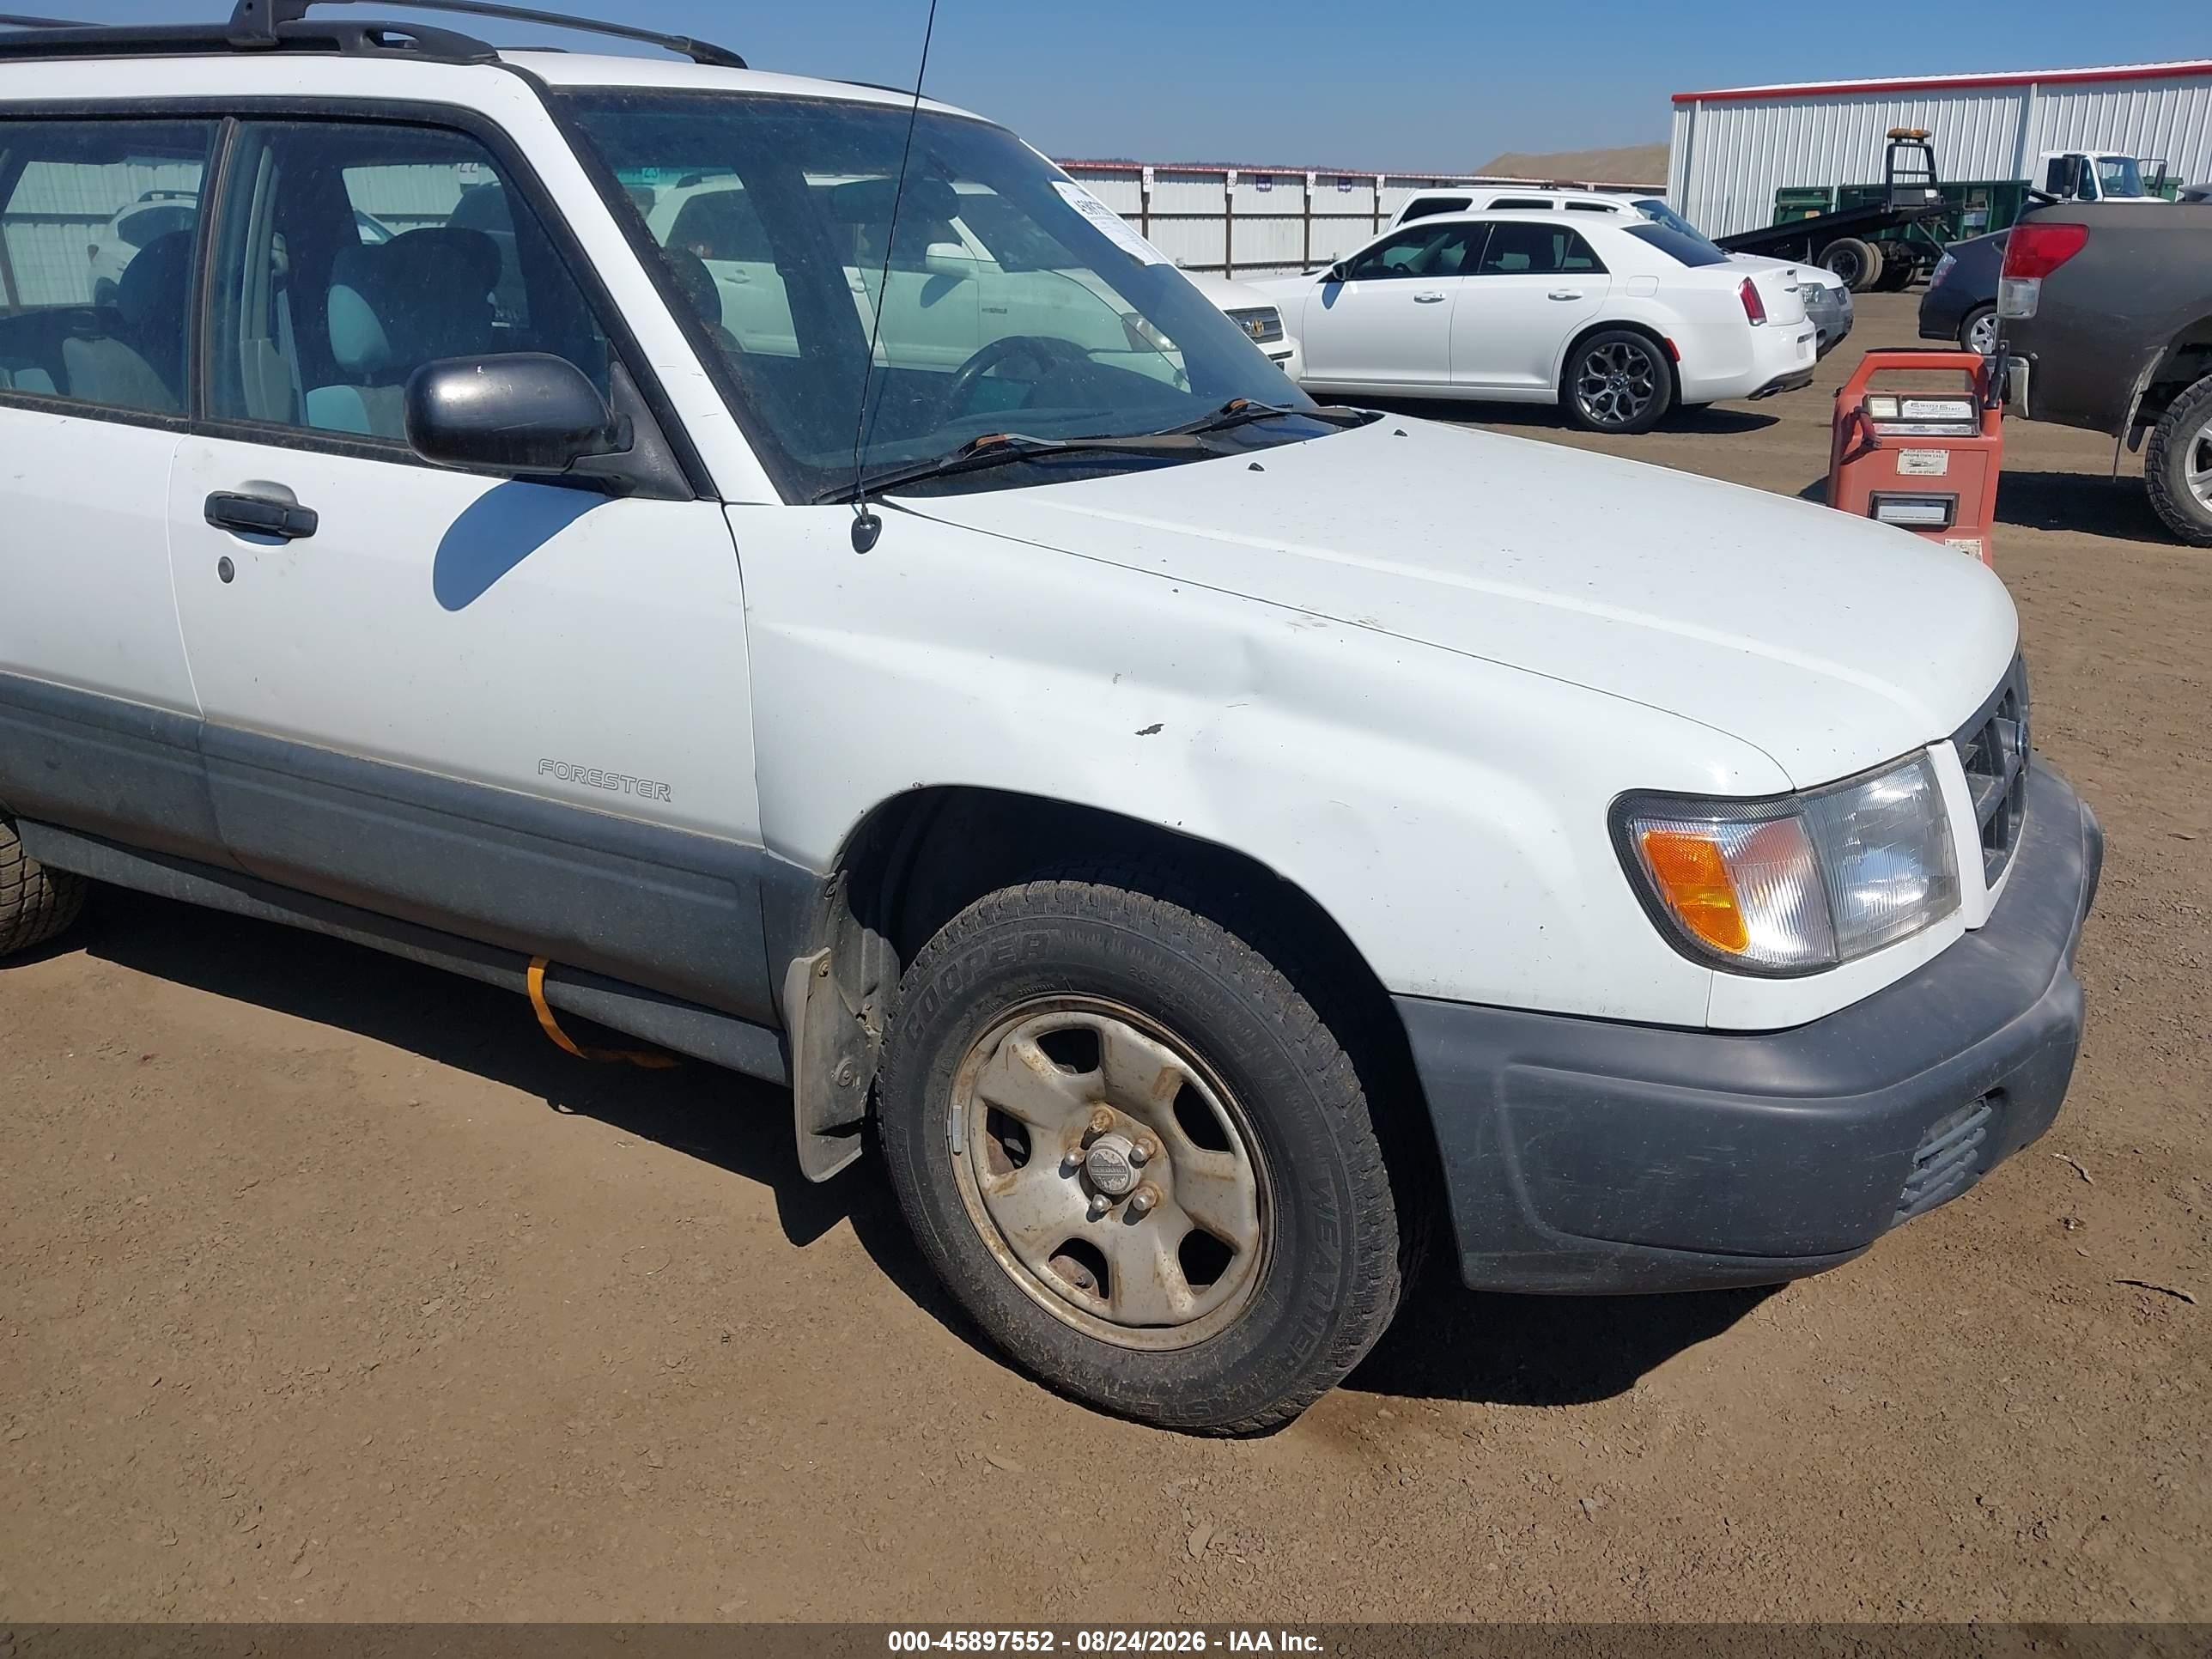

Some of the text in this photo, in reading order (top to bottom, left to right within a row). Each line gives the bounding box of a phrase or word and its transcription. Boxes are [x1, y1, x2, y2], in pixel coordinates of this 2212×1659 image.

[1144, 173, 1154, 185] 27
[538, 758, 672, 803] FORESTER
[902, 928, 1049, 1050] COOPER
